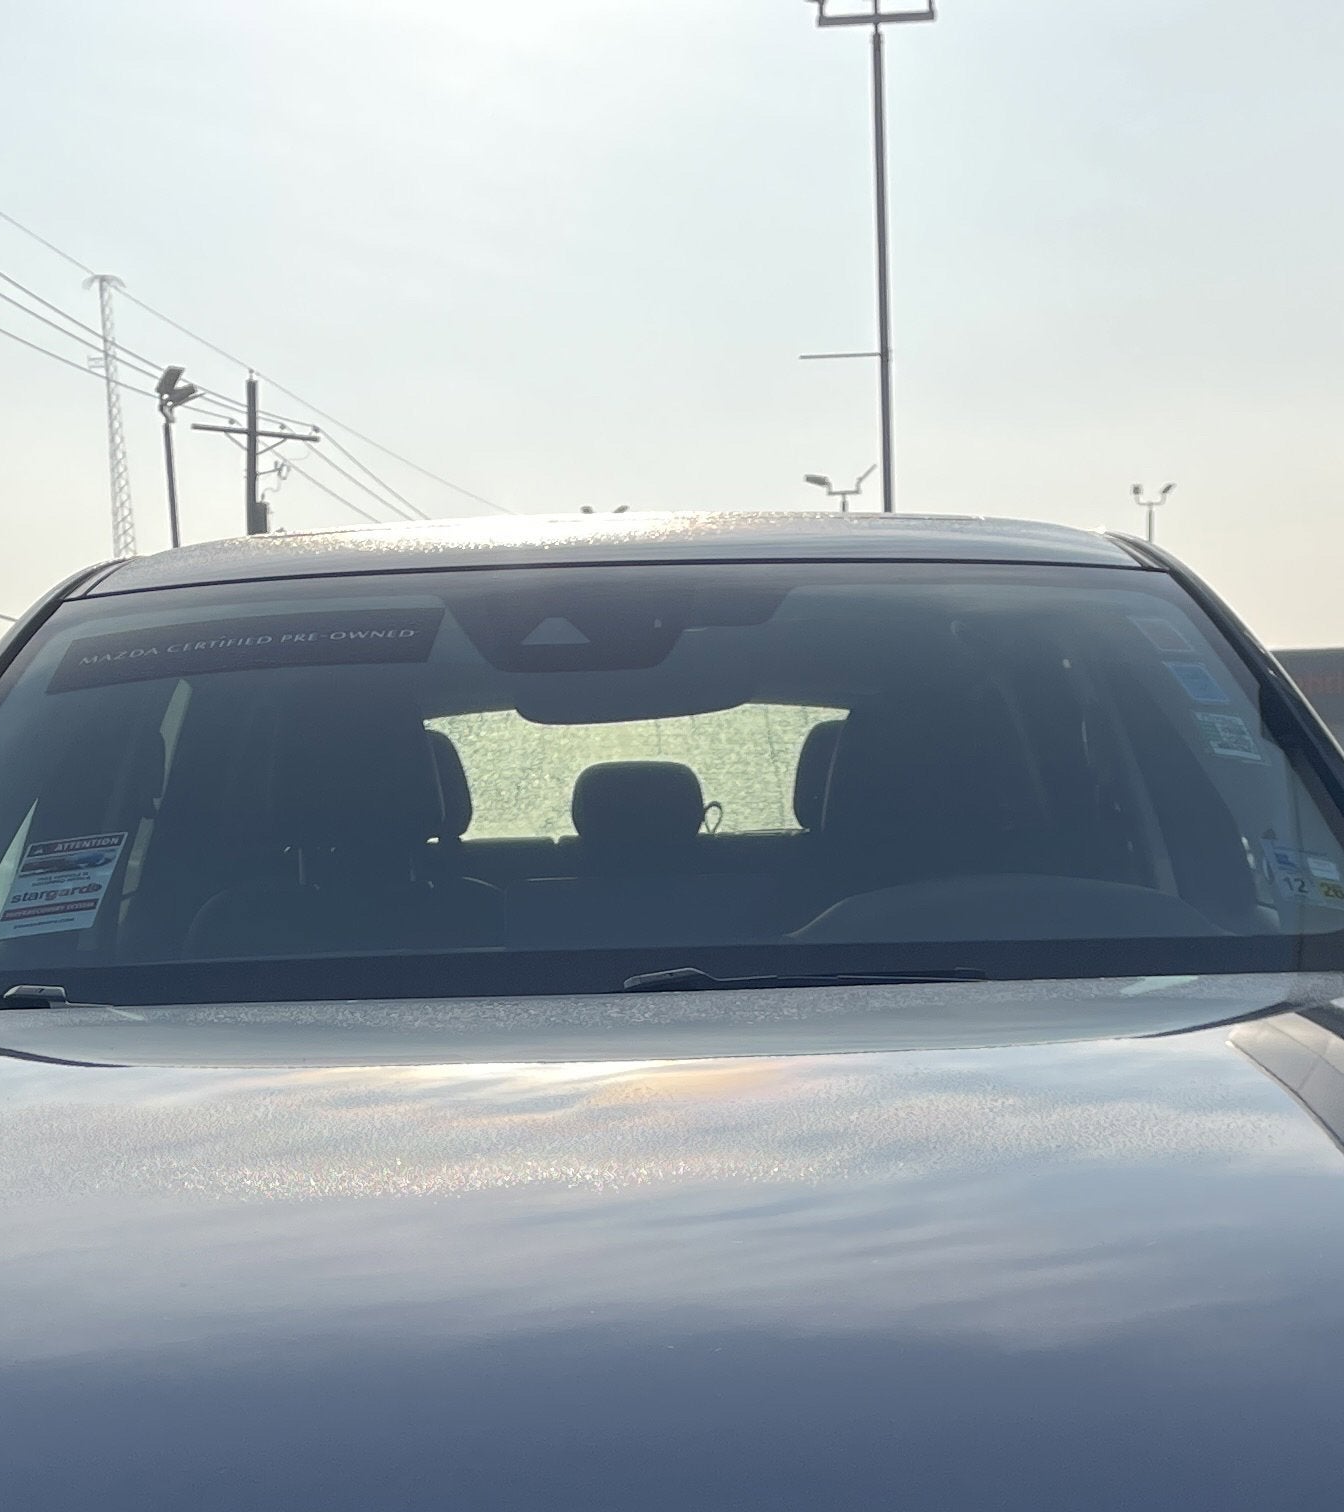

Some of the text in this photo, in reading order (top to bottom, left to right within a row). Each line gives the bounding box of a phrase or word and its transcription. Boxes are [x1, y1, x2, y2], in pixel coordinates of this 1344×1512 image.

[79, 629, 417, 666] MAZDA CERTIFIED PRE-OWNED
[54, 837, 119, 851] ATTENTION
[1285, 876, 1309, 894] 12
